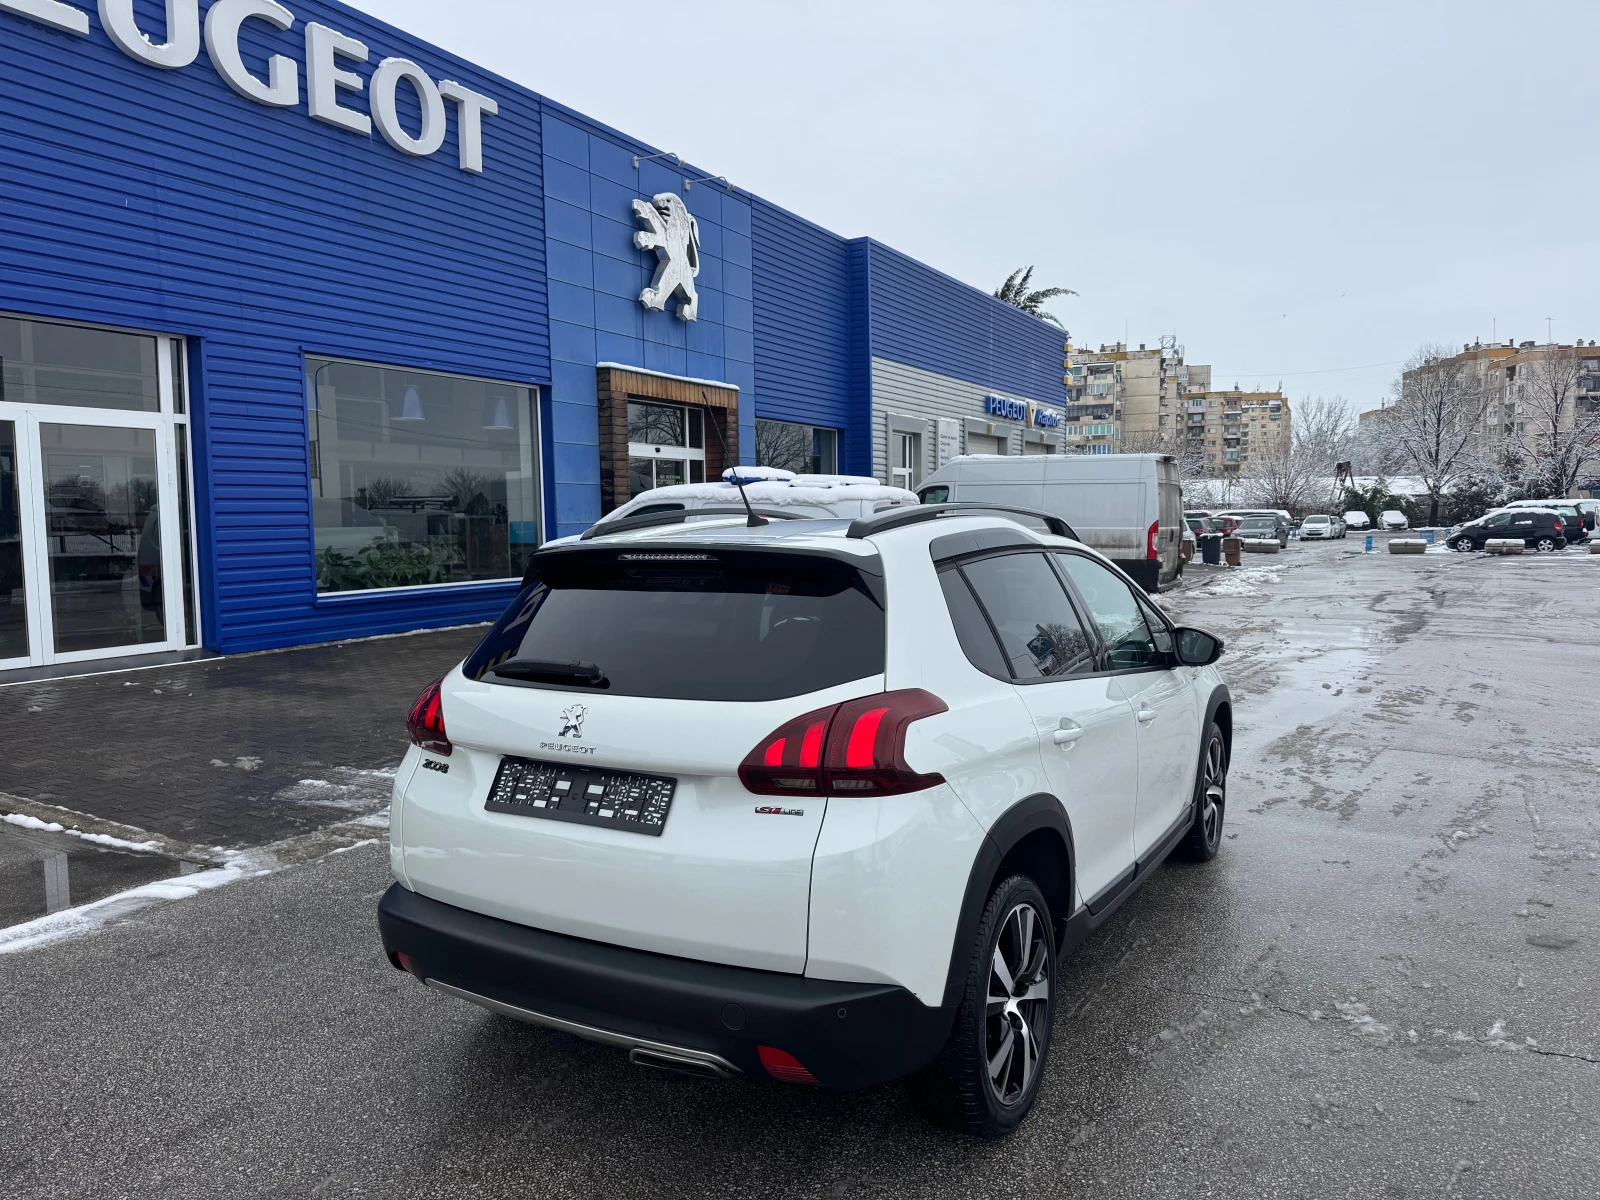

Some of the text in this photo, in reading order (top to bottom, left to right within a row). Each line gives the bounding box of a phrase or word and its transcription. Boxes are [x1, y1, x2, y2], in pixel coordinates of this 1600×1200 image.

[990, 396, 1026, 420] PEUGEOT
[539, 741, 597, 755] PEUGEOT
[422, 758, 450, 774] 2008
[756, 806, 777, 815] GT
